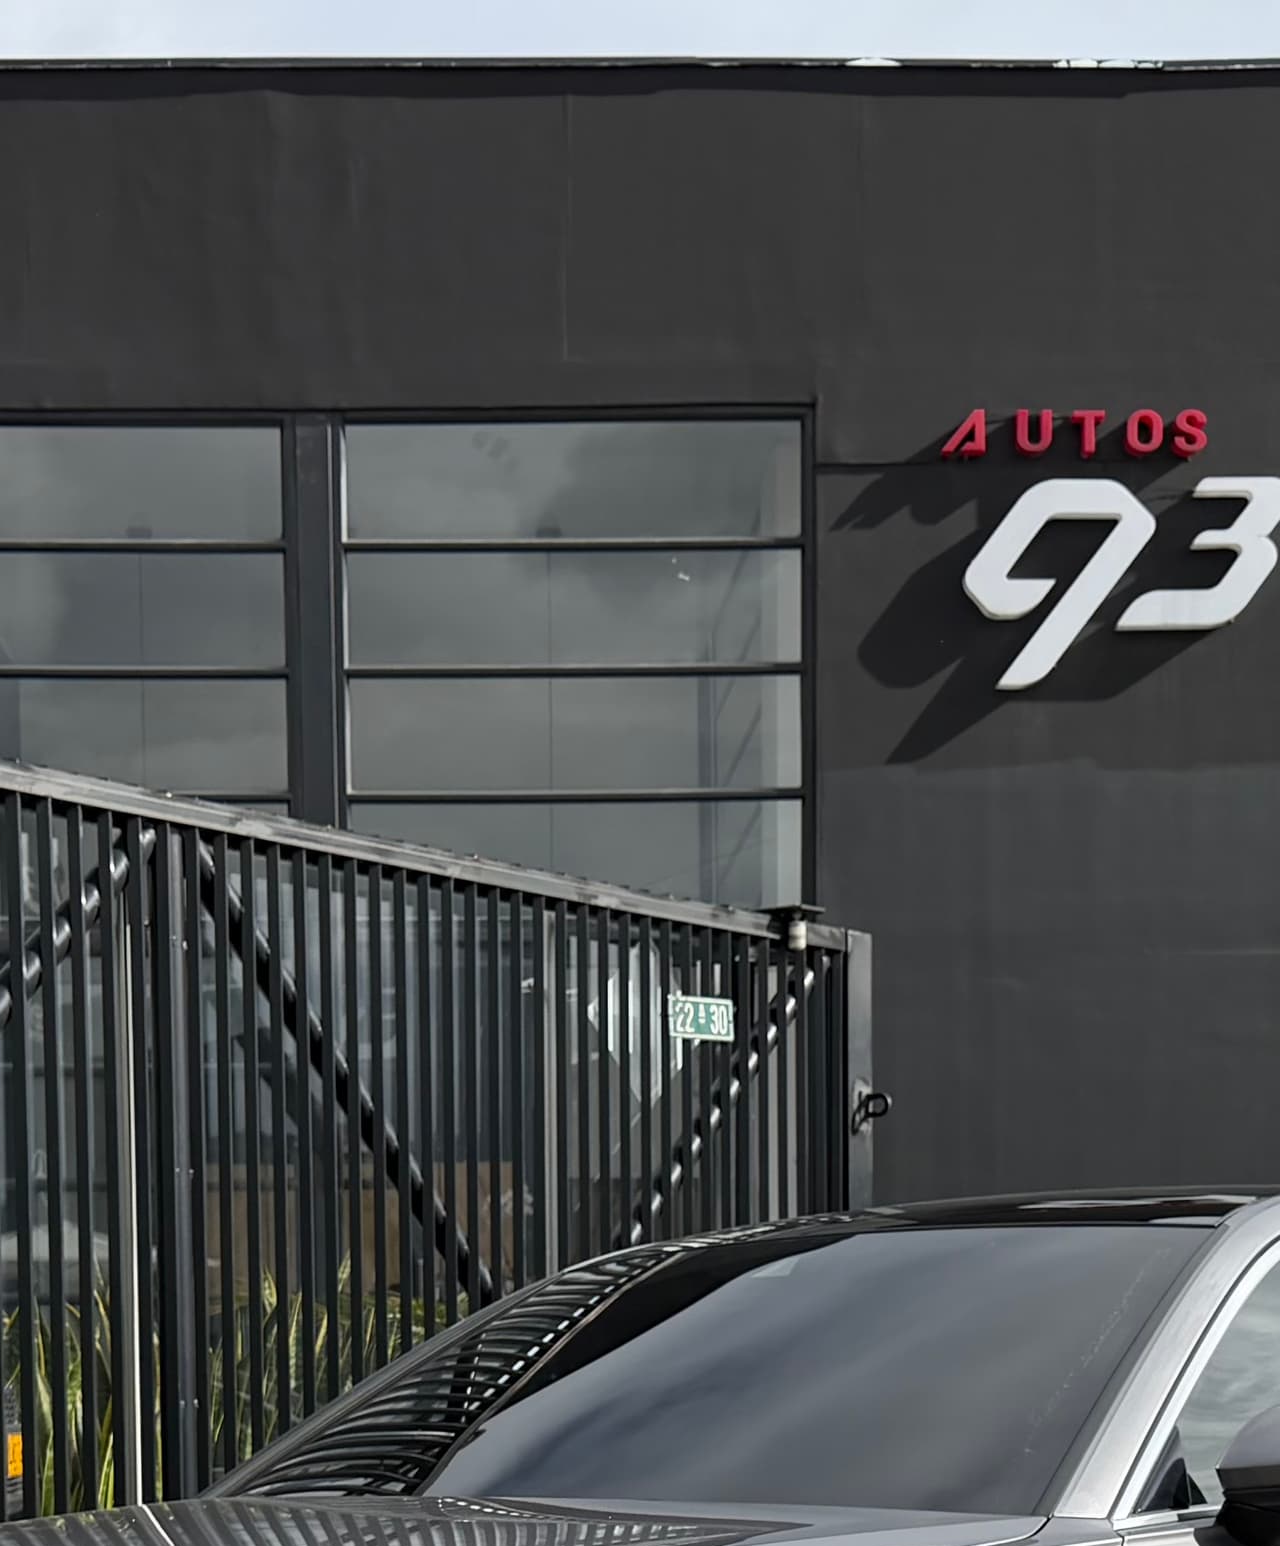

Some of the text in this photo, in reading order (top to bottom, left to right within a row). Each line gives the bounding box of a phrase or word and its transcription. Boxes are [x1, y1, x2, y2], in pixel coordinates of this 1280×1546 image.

[940, 408, 1209, 458] AUTOS
[675, 1002, 695, 1033] 22
[709, 1004, 728, 1035] 30
